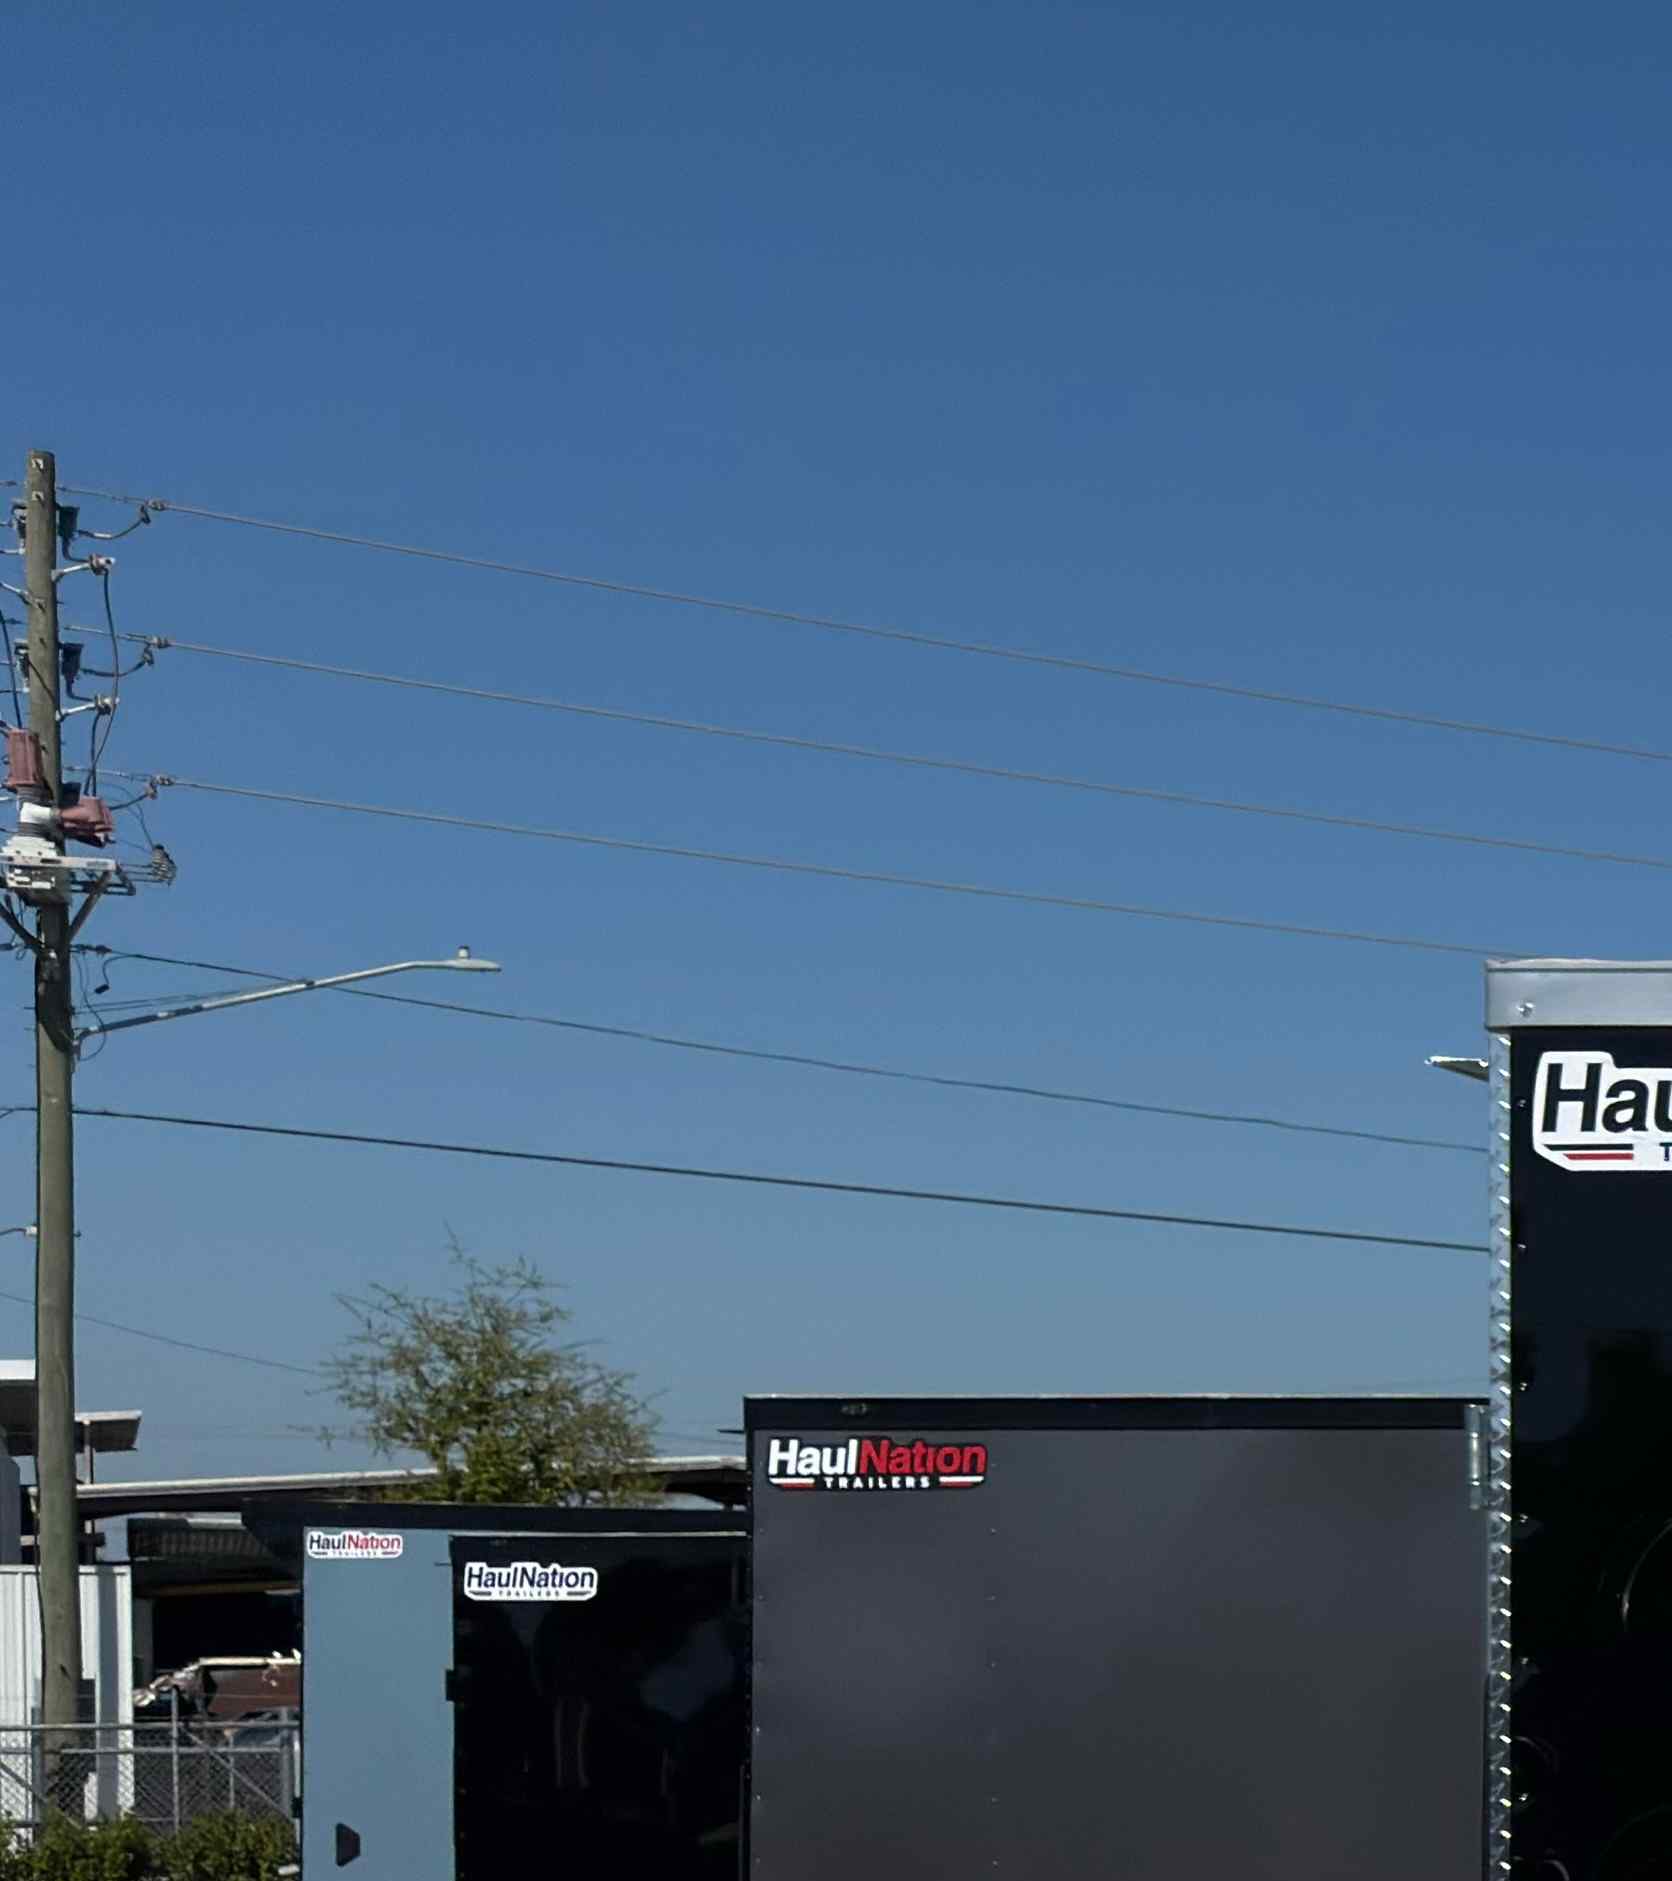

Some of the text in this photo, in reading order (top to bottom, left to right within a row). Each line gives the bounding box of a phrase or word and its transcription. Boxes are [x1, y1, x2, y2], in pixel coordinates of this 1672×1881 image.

[768, 1439, 987, 1475] HaulNation
[824, 1476, 930, 1488] TRAILERS
[467, 1566, 595, 1588] HaulNation
